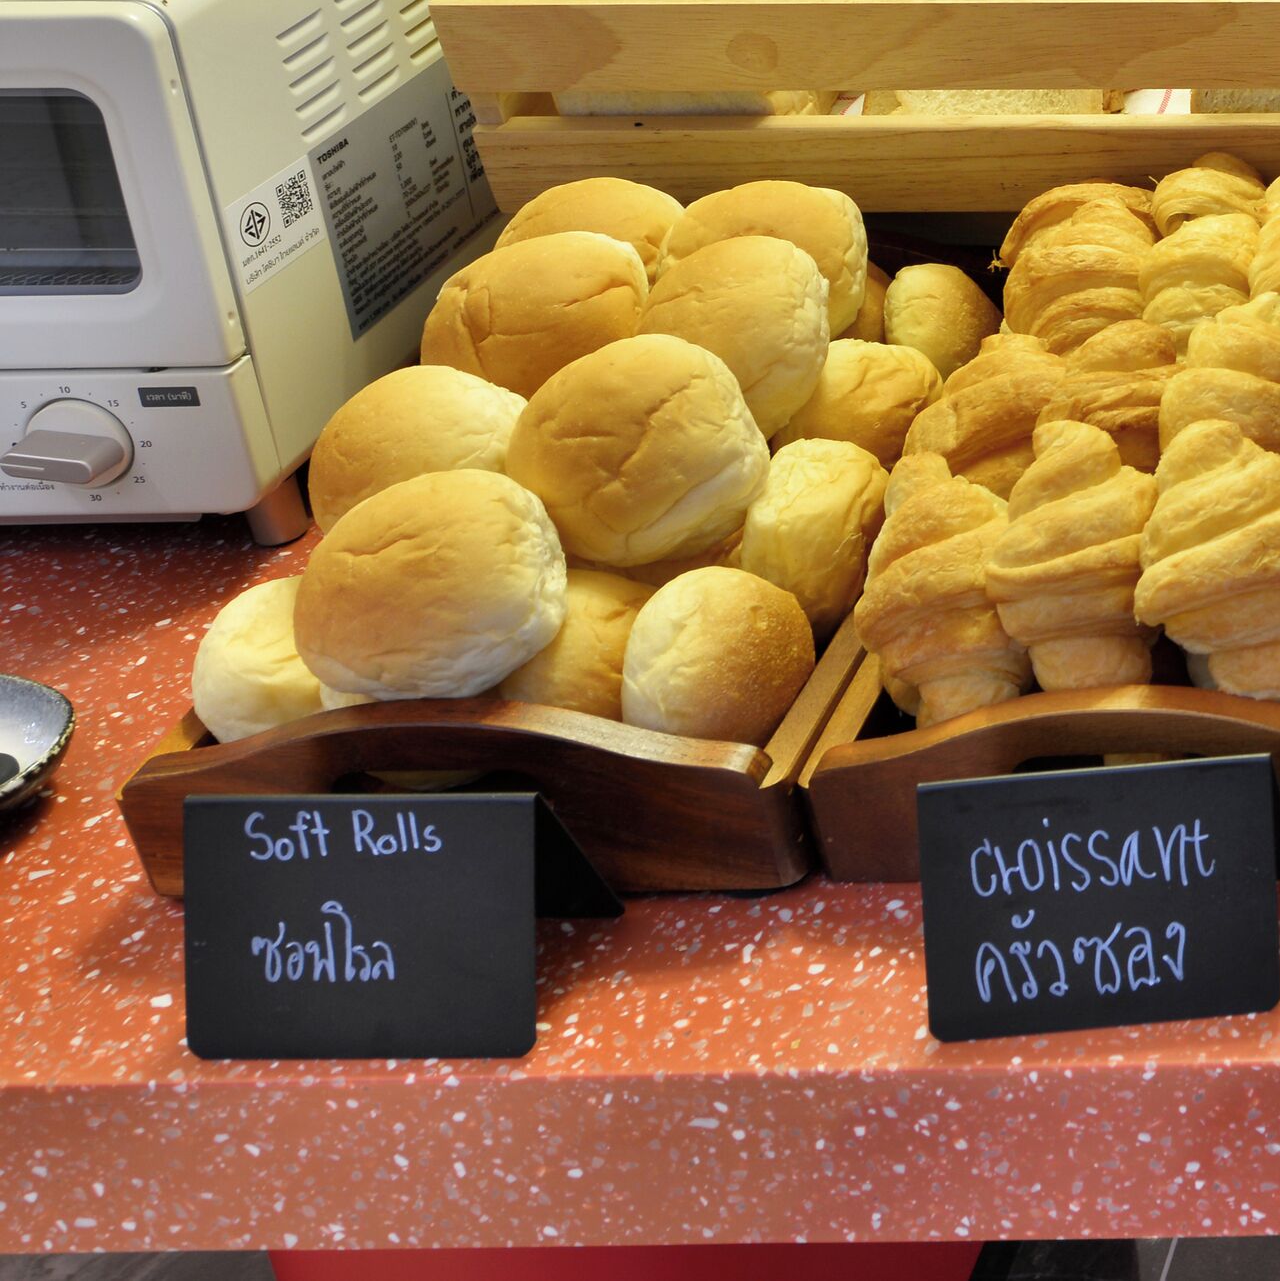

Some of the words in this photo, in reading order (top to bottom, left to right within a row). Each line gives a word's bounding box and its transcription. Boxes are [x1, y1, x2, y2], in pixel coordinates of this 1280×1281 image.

[316, 138, 349, 164] TOSHIBA
[59, 386, 71, 394] 10
[20, 401, 27, 409] 5
[107, 399, 120, 407] 15
[140, 440, 152, 448] 20
[90, 494, 102, 502] 30
[244, 809, 330, 860] Soft
[351, 809, 443, 856] Rolls
[974, 909, 1187, 1003] ครัวซอง
